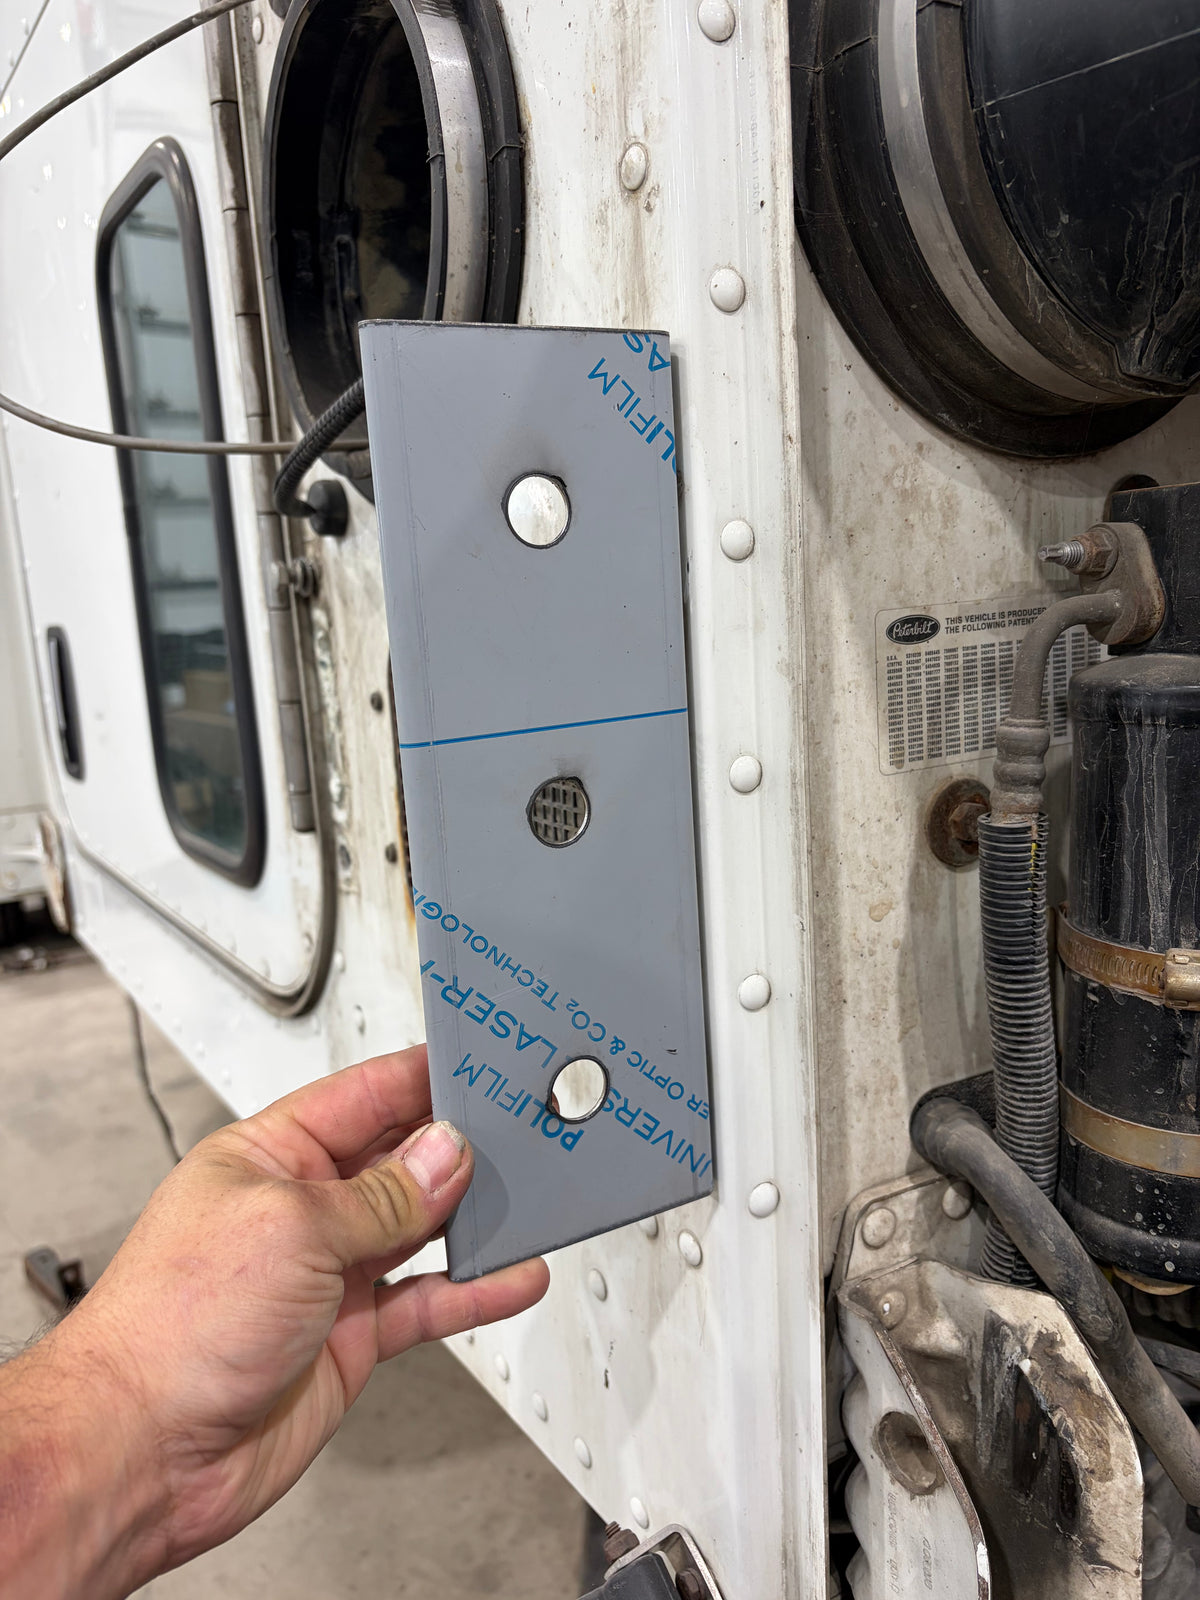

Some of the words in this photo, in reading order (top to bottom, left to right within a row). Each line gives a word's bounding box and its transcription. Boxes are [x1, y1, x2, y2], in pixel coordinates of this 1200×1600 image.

[587, 357, 676, 475] LIFILM
[893, 620, 935, 639] Peterbilt
[945, 616, 962, 625] THIS
[964, 612, 996, 623] VEHICLE
[998, 611, 1005, 620] IS
[945, 626, 960, 634] THE
[962, 620, 1006, 632] FOLLOWING
[413, 887, 559, 1012] TECHNOLOGI
[610, 1036, 626, 1056] &
[626, 1051, 684, 1100] OPTIC
[452, 1053, 584, 1152] POLIFILM
